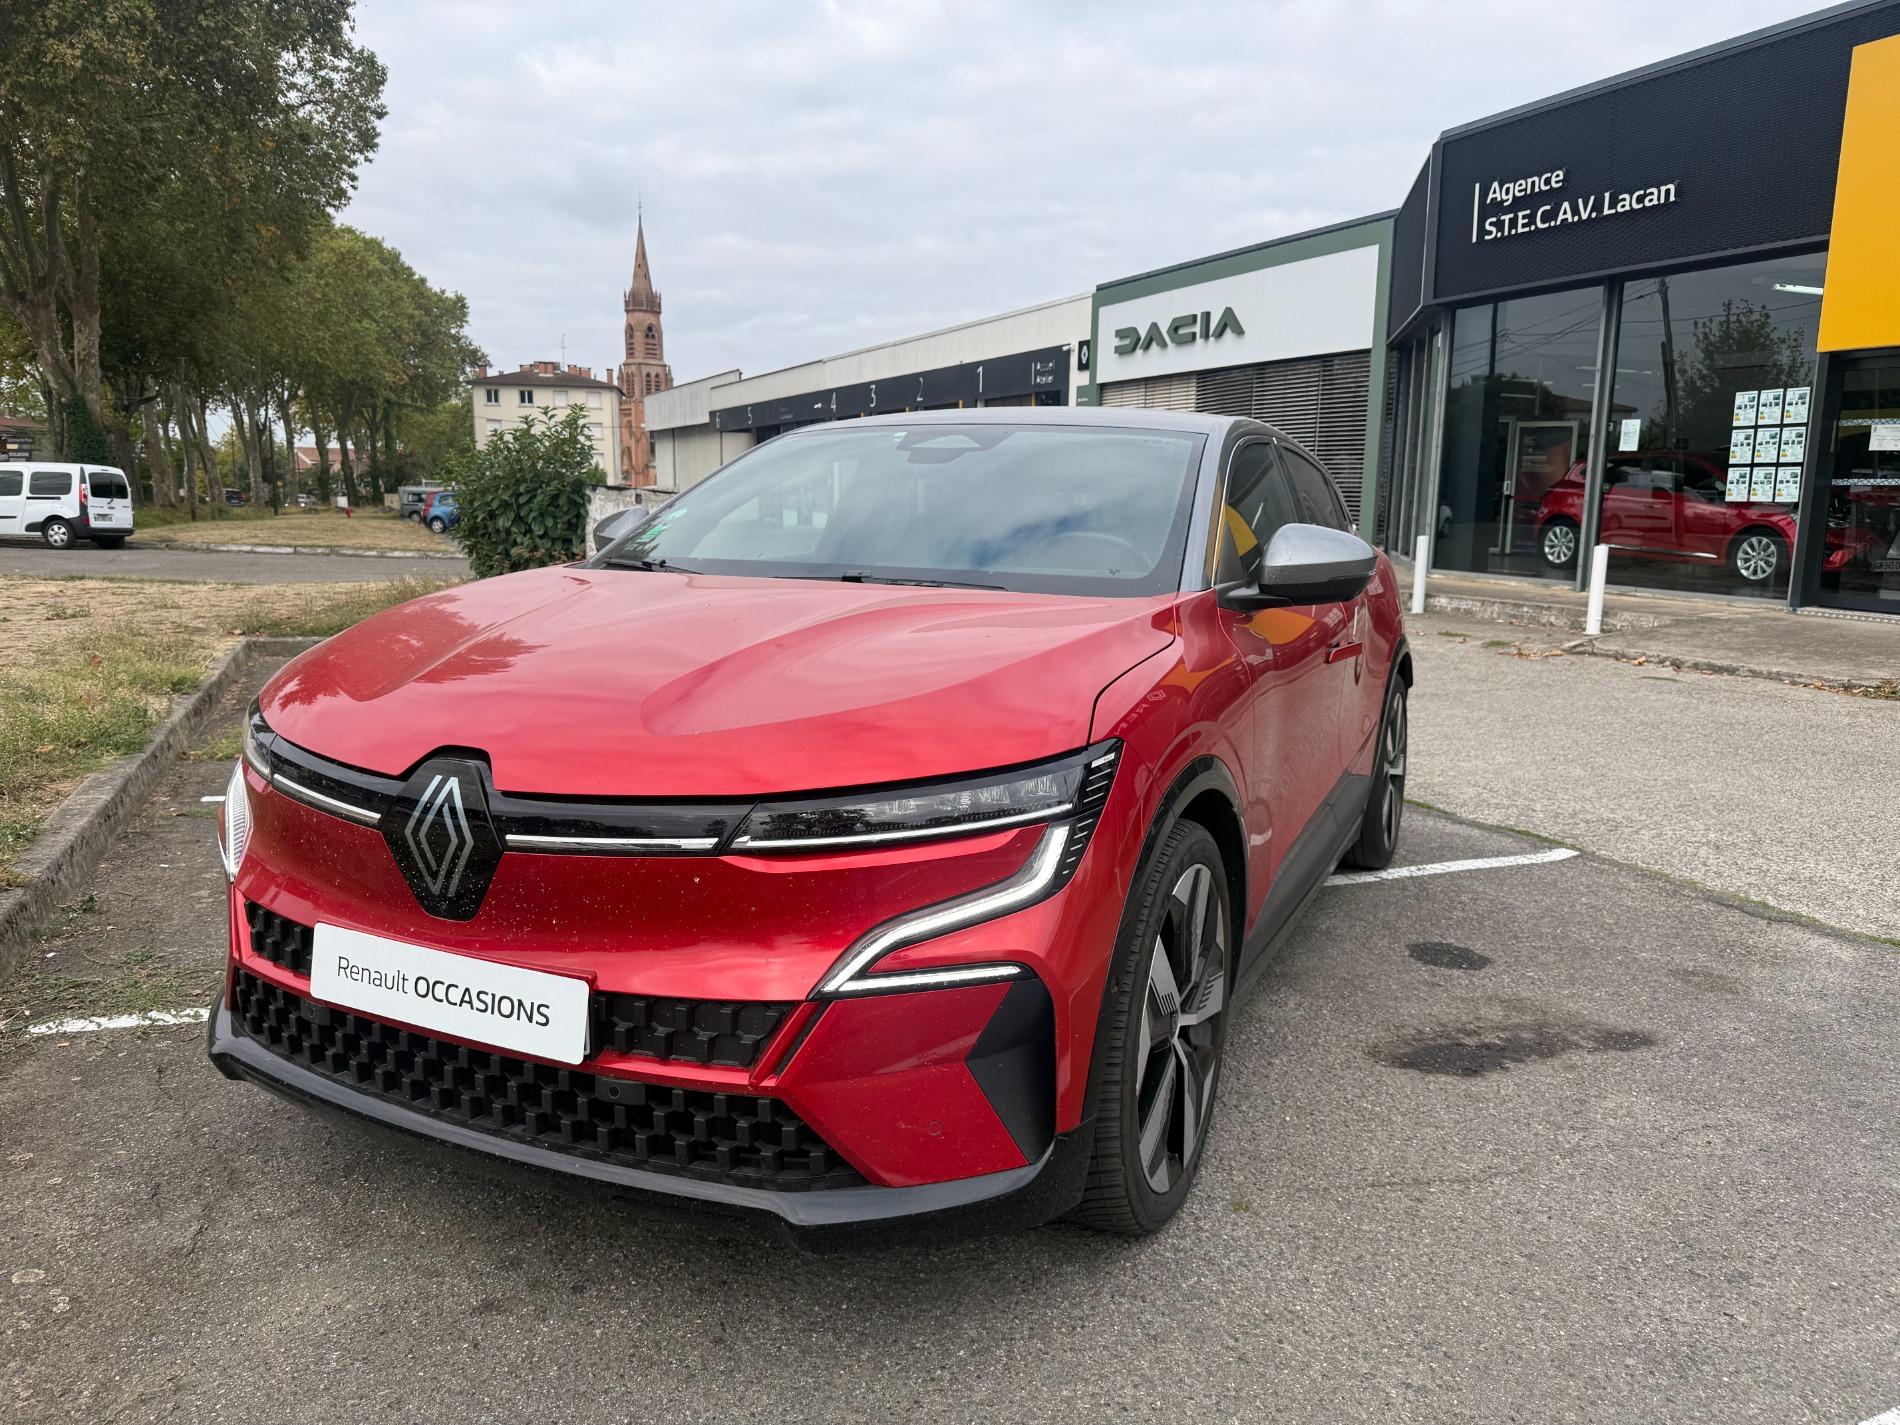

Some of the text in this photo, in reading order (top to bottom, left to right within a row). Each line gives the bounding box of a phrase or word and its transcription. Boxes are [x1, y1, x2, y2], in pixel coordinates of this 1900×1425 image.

[1486, 169, 1565, 207] Agence
[1484, 182, 1677, 240] S.T.E.C.A.V. Lacan
[1114, 306, 1246, 355] DACIA
[916, 377, 924, 402] 2
[976, 365, 983, 393] 1
[830, 391, 837, 413] 4
[869, 384, 877, 408] 3
[747, 406, 753, 425] 5
[336, 955, 551, 1028] Renault OCCASIONS
